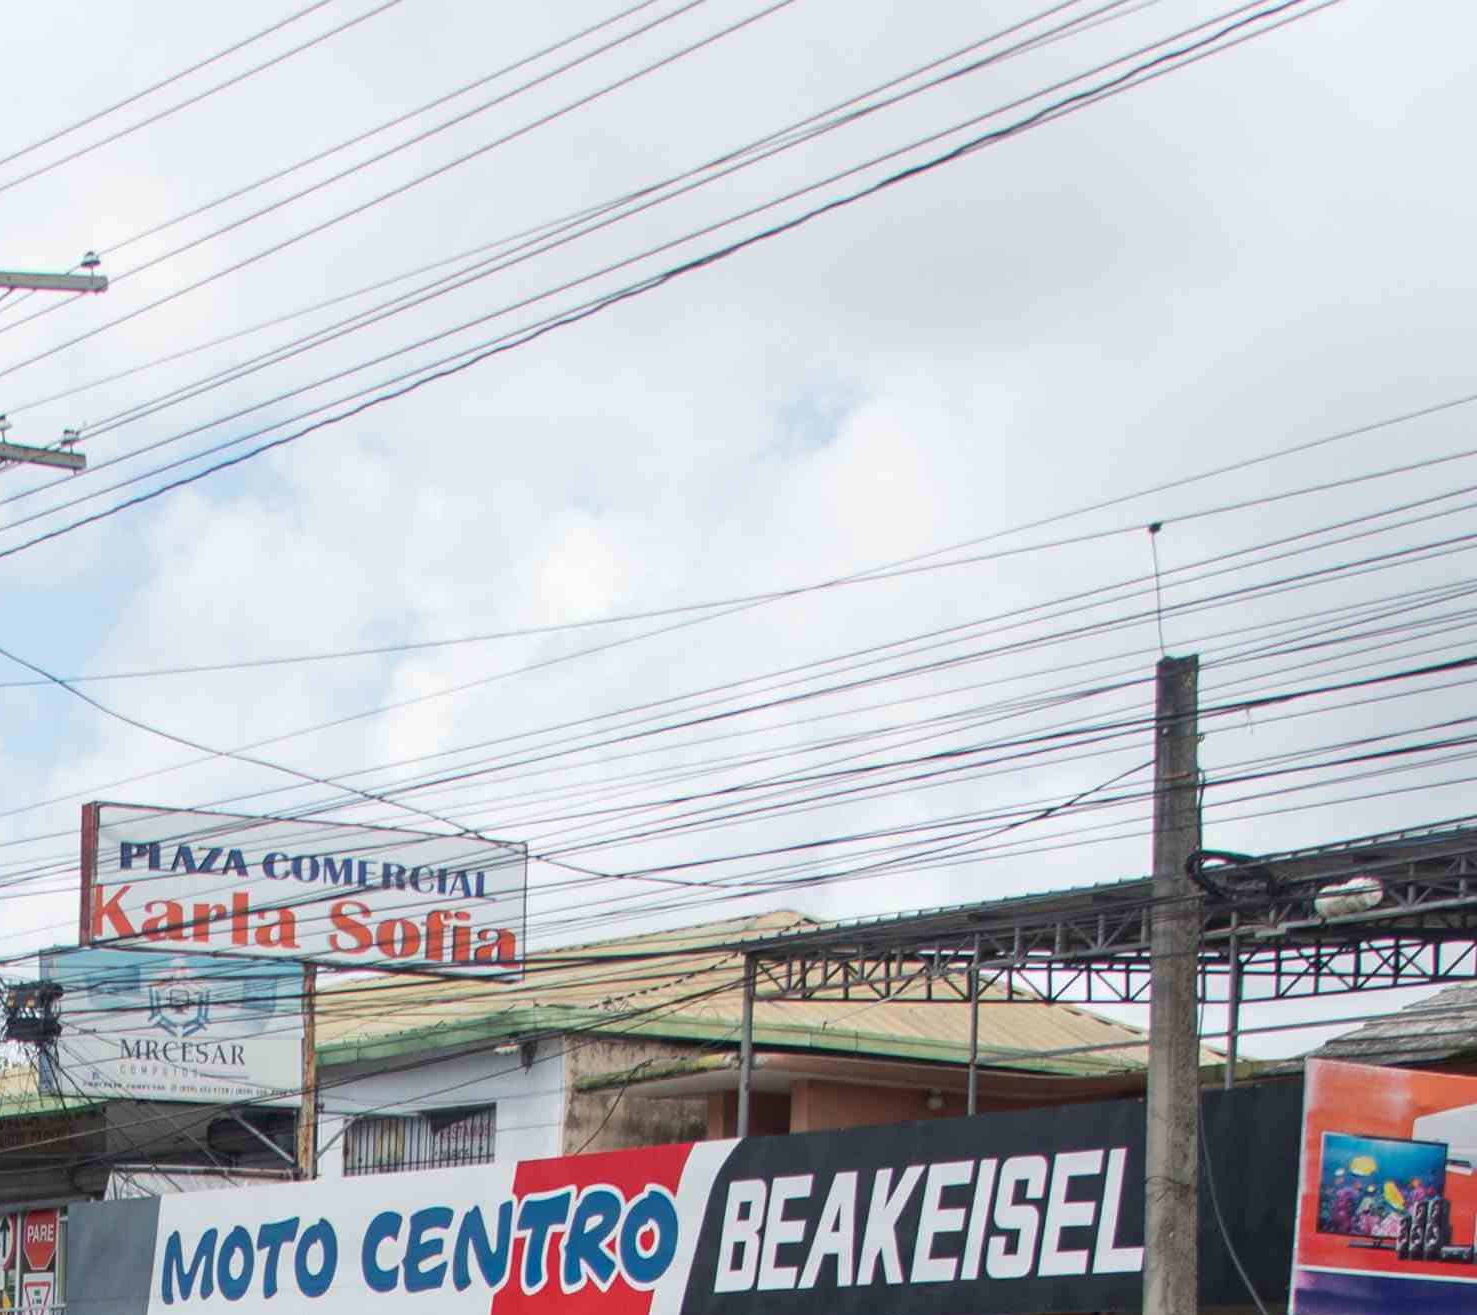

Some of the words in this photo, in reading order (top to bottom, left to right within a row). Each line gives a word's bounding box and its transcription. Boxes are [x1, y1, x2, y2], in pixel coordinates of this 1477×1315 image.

[119, 841, 249, 878] PLAZA
[262, 852, 495, 900] COMERCIAL
[93, 884, 300, 949] Karla
[328, 899, 519, 968] Sofia
[119, 1038, 246, 1065] MRCESAR
[27, 1223, 55, 1244] PARE
[161, 1214, 338, 1305] MOTO
[361, 1188, 681, 1295] CENTRO
[712, 1149, 1145, 1295] BEAKEISEL
